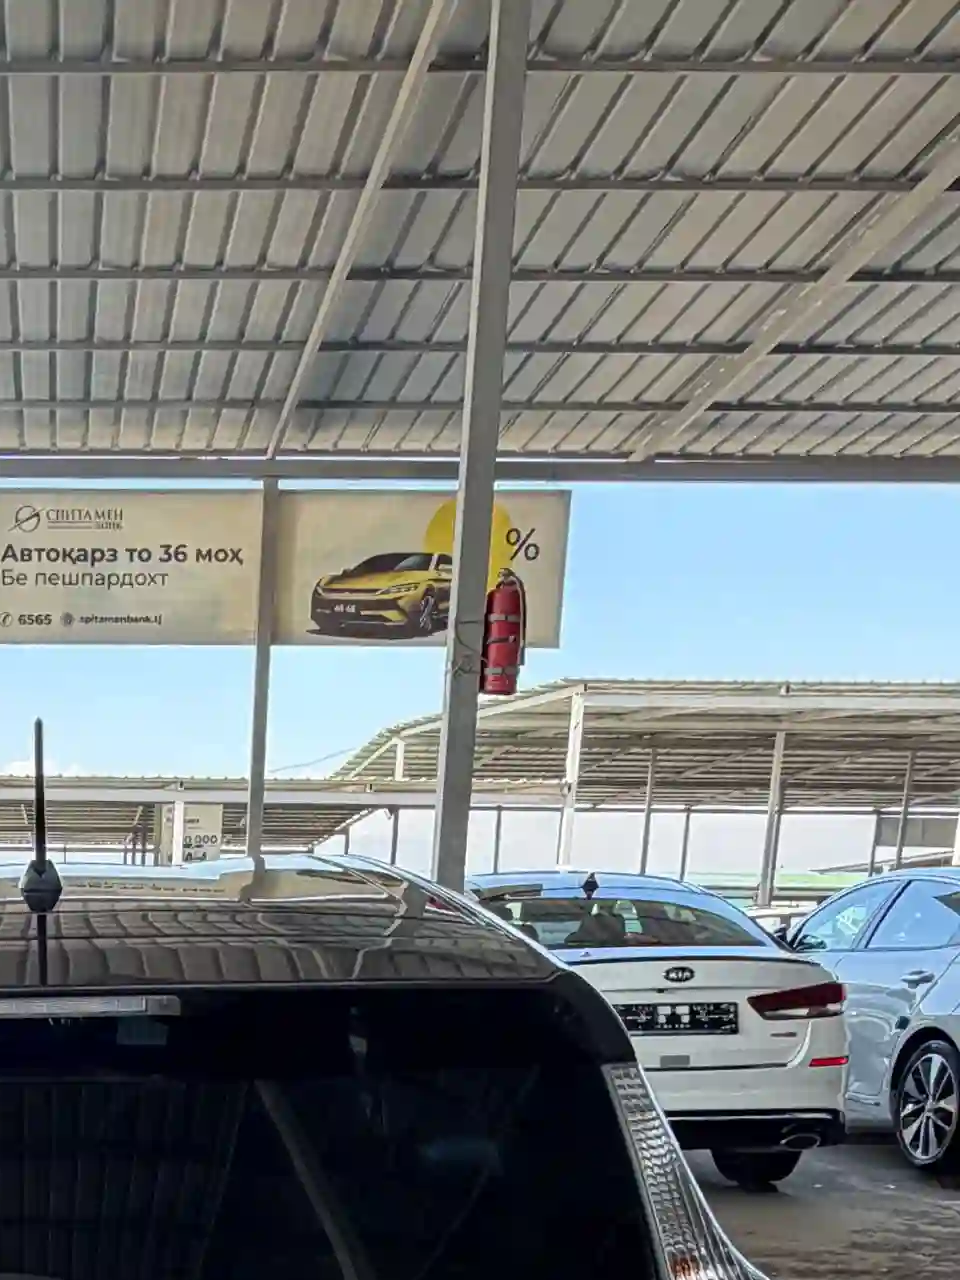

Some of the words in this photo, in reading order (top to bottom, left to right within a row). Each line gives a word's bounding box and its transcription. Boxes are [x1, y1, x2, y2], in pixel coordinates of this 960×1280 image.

[1, 544, 118, 567] Автоқарз
[125, 547, 151, 563] то
[158, 544, 187, 563] 36
[195, 547, 244, 566] моҳ
[1, 569, 28, 586] Бе
[34, 571, 169, 590] пешпардохт
[18, 614, 52, 626] 6565
[668, 970, 692, 979] KIA
